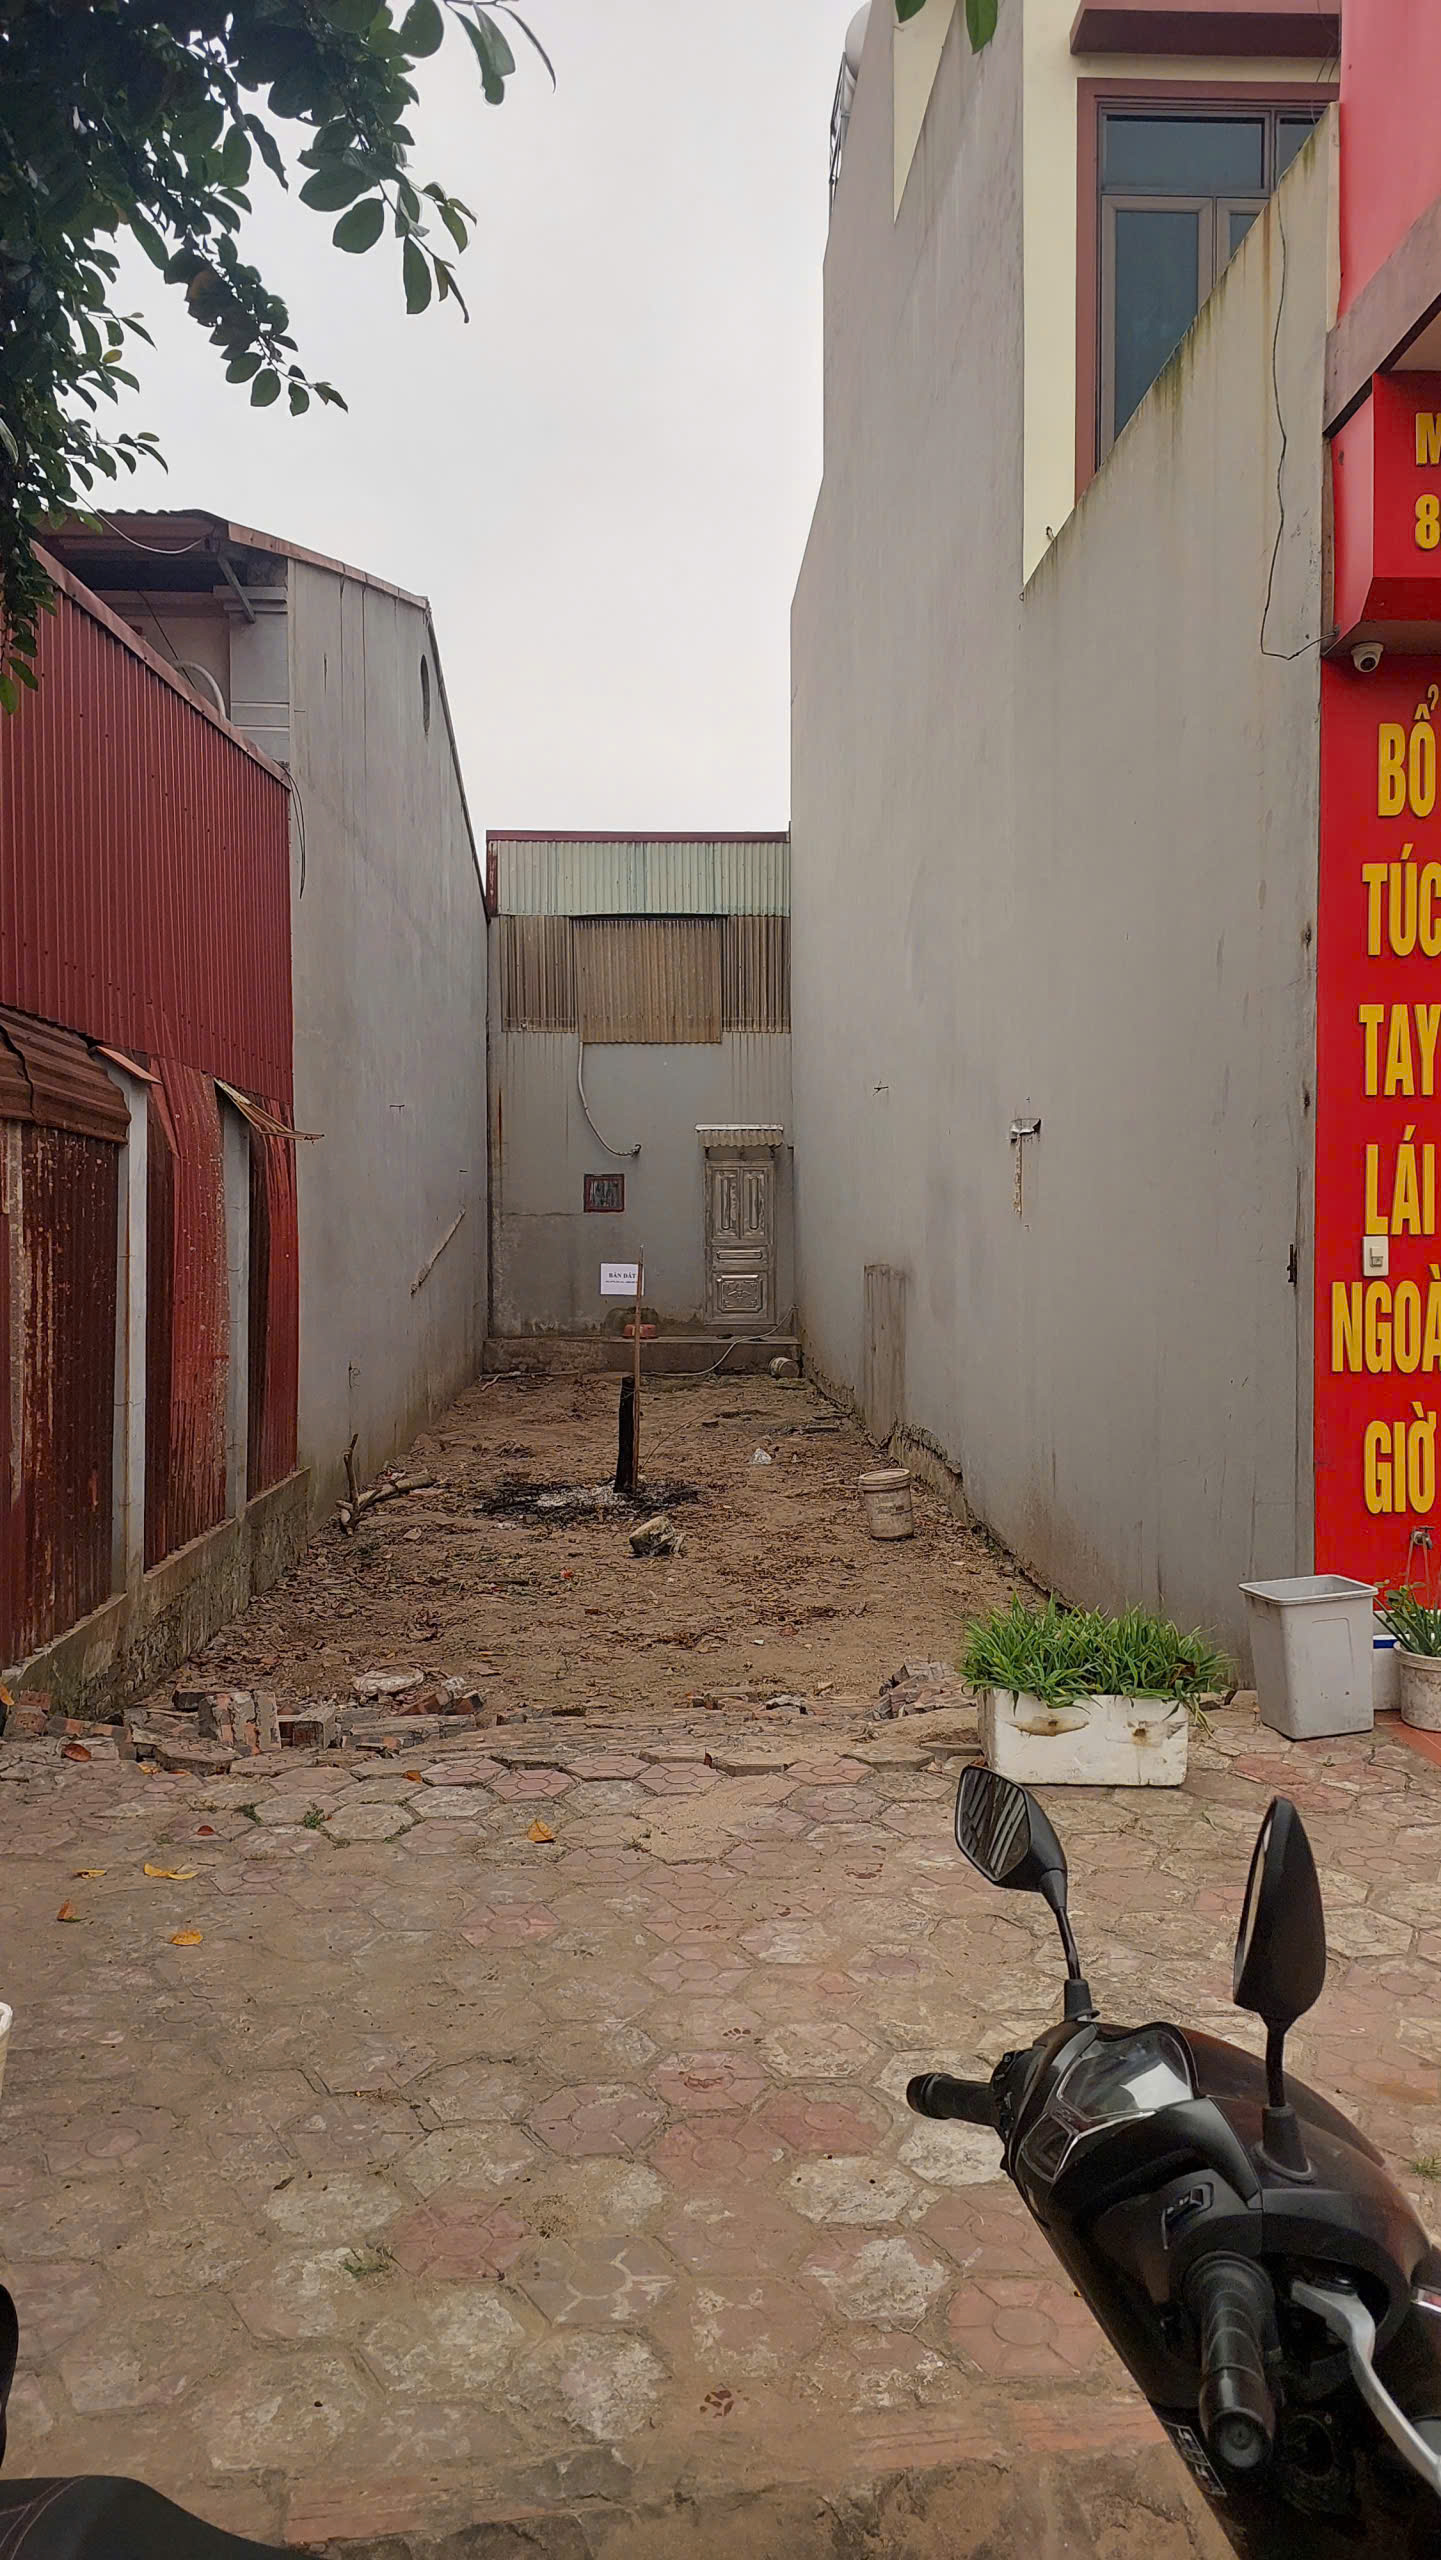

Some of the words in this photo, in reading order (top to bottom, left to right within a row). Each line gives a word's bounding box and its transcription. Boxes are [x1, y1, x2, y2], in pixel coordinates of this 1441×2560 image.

[1378, 684, 1439, 817] BỔ
[1362, 844, 1441, 957] TÚC
[1359, 1004, 1441, 1095] TAY
[1365, 1125, 1435, 1235] LÁI
[1331, 1264, 1441, 1373] NGOÀ
[1364, 1402, 1436, 1514] GIỜ
